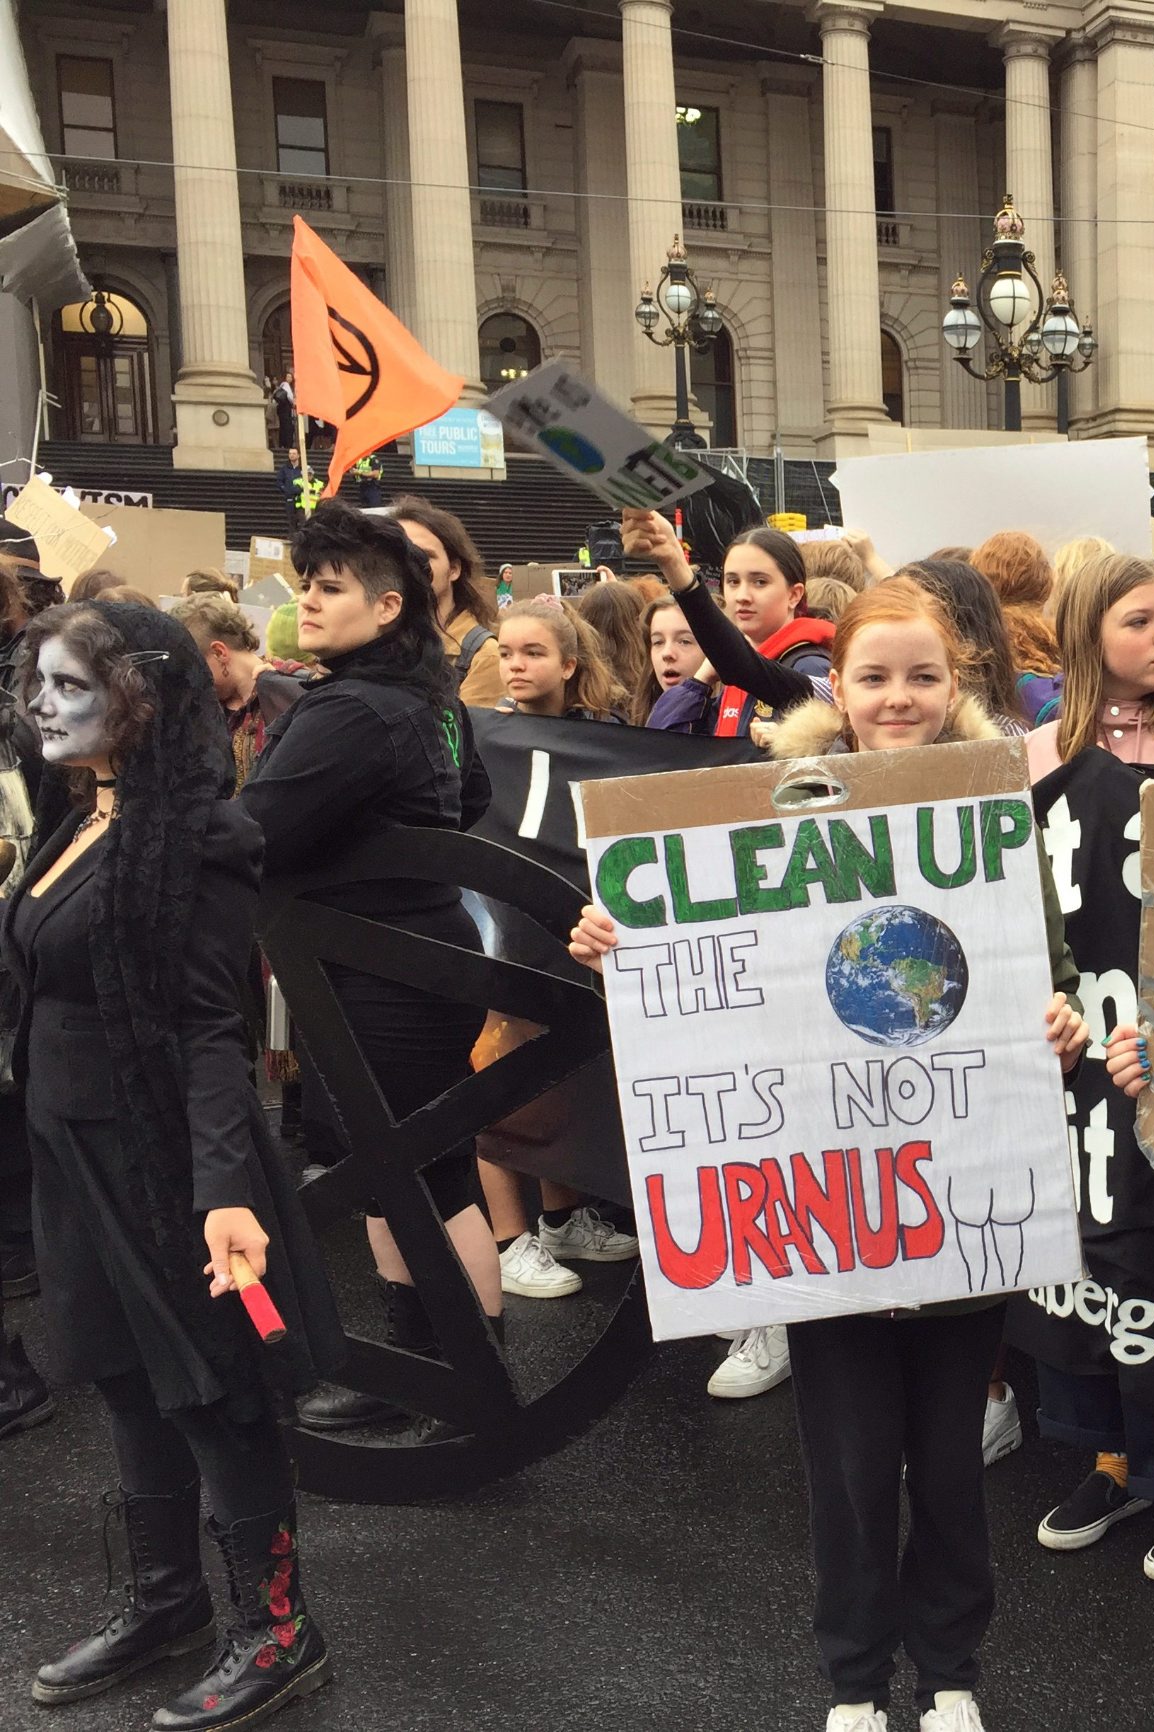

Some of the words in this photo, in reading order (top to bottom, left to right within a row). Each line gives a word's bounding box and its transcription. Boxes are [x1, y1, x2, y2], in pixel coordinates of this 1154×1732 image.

[420, 440, 457, 455] TOURS
[439, 426, 478, 441] PUBLIC
[595, 815, 897, 929] CLEAN
[917, 799, 1032, 889] UP
[614, 930, 764, 1019] THE
[632, 1064, 785, 1152] IT'S
[831, 1049, 986, 1130] NOT
[645, 1141, 945, 1289] URANUS
